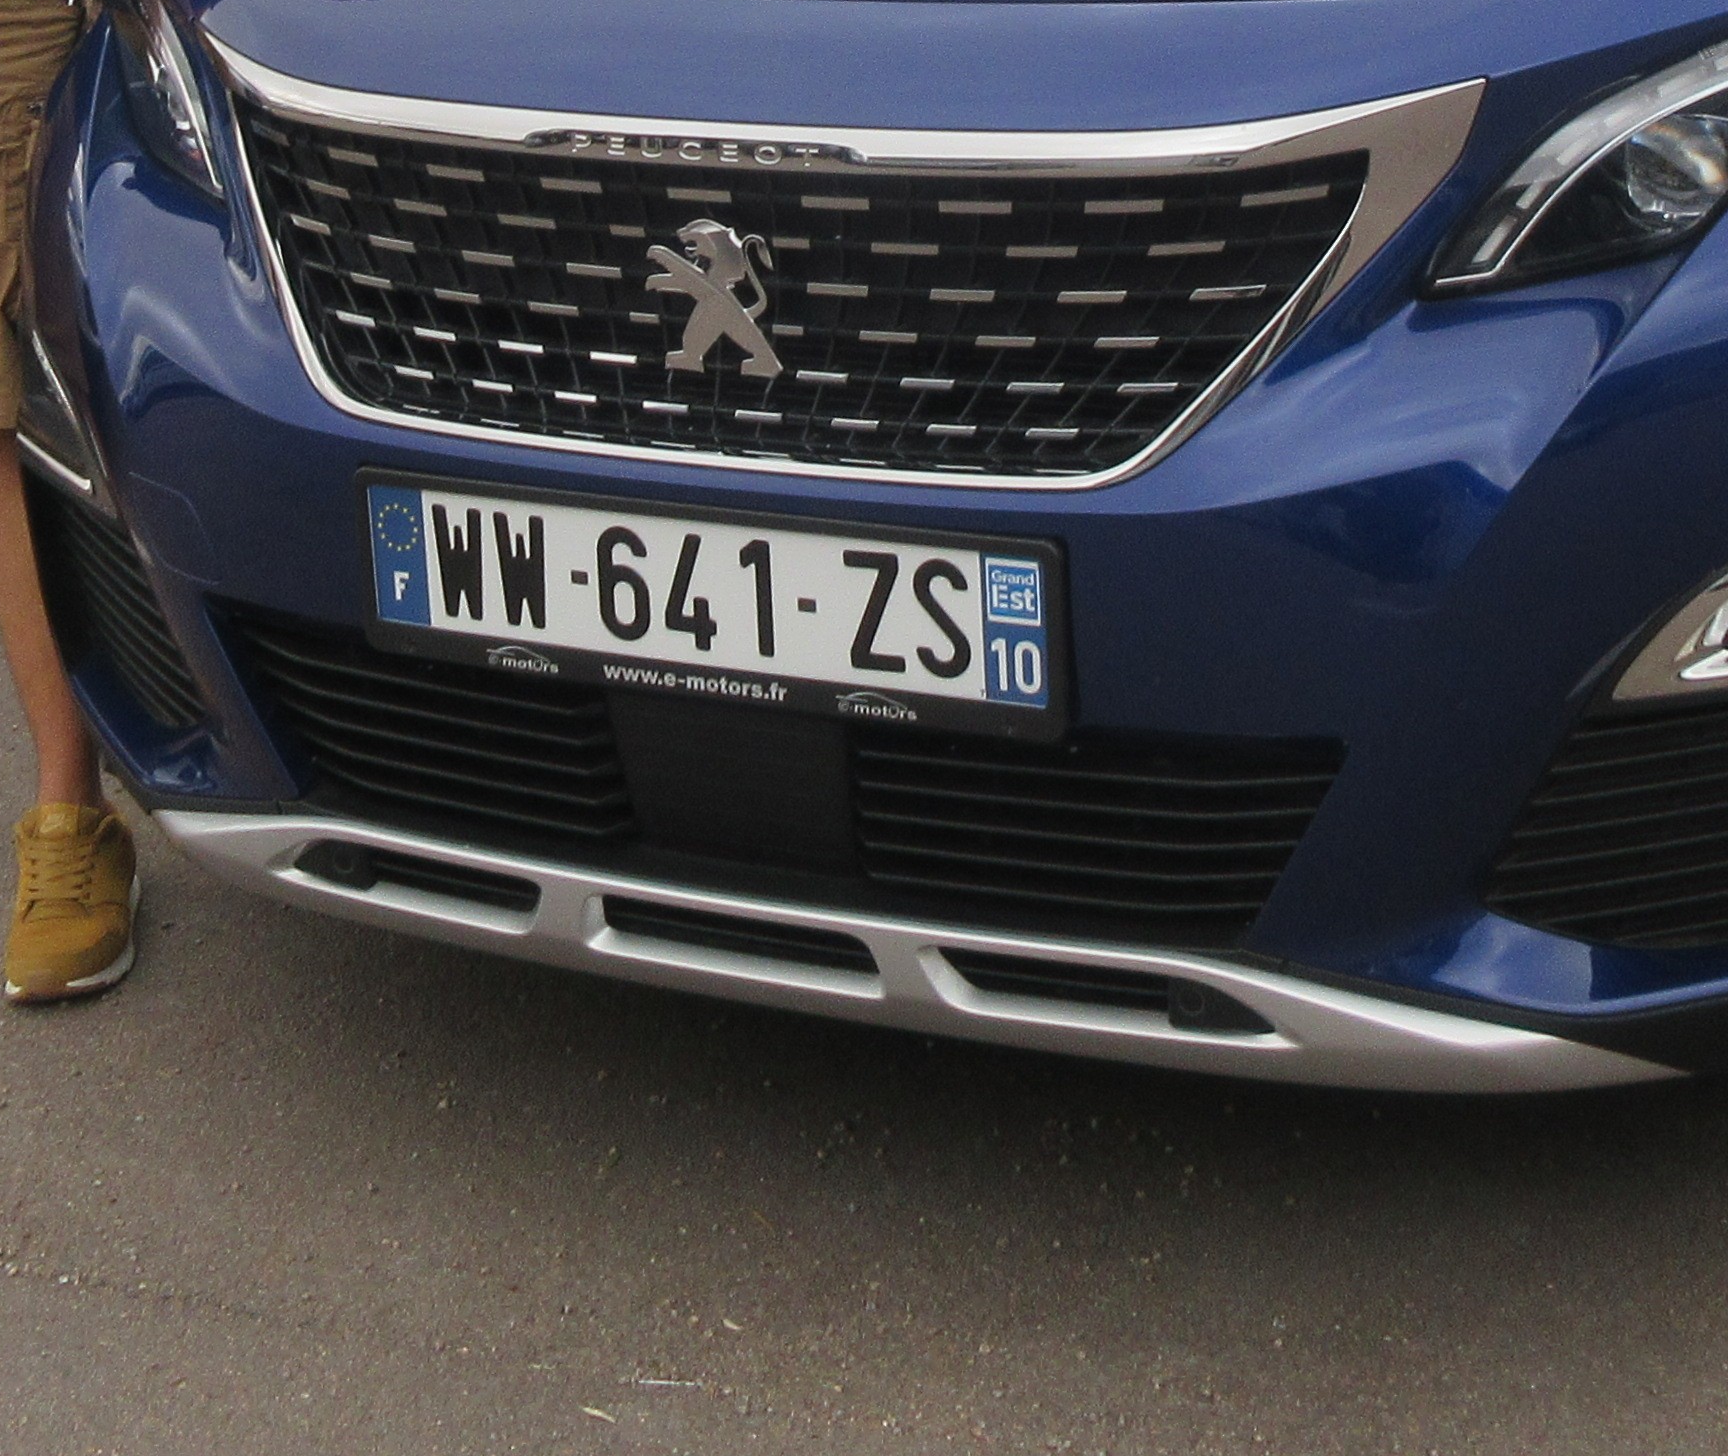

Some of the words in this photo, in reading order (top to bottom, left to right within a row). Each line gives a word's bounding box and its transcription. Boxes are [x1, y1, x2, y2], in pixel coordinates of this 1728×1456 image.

[393, 571, 409, 601] F
[990, 569, 1035, 586] Grand
[991, 584, 1036, 612] Est
[990, 638, 1042, 694] 10
[603, 663, 788, 702] www.e-motors.fr
